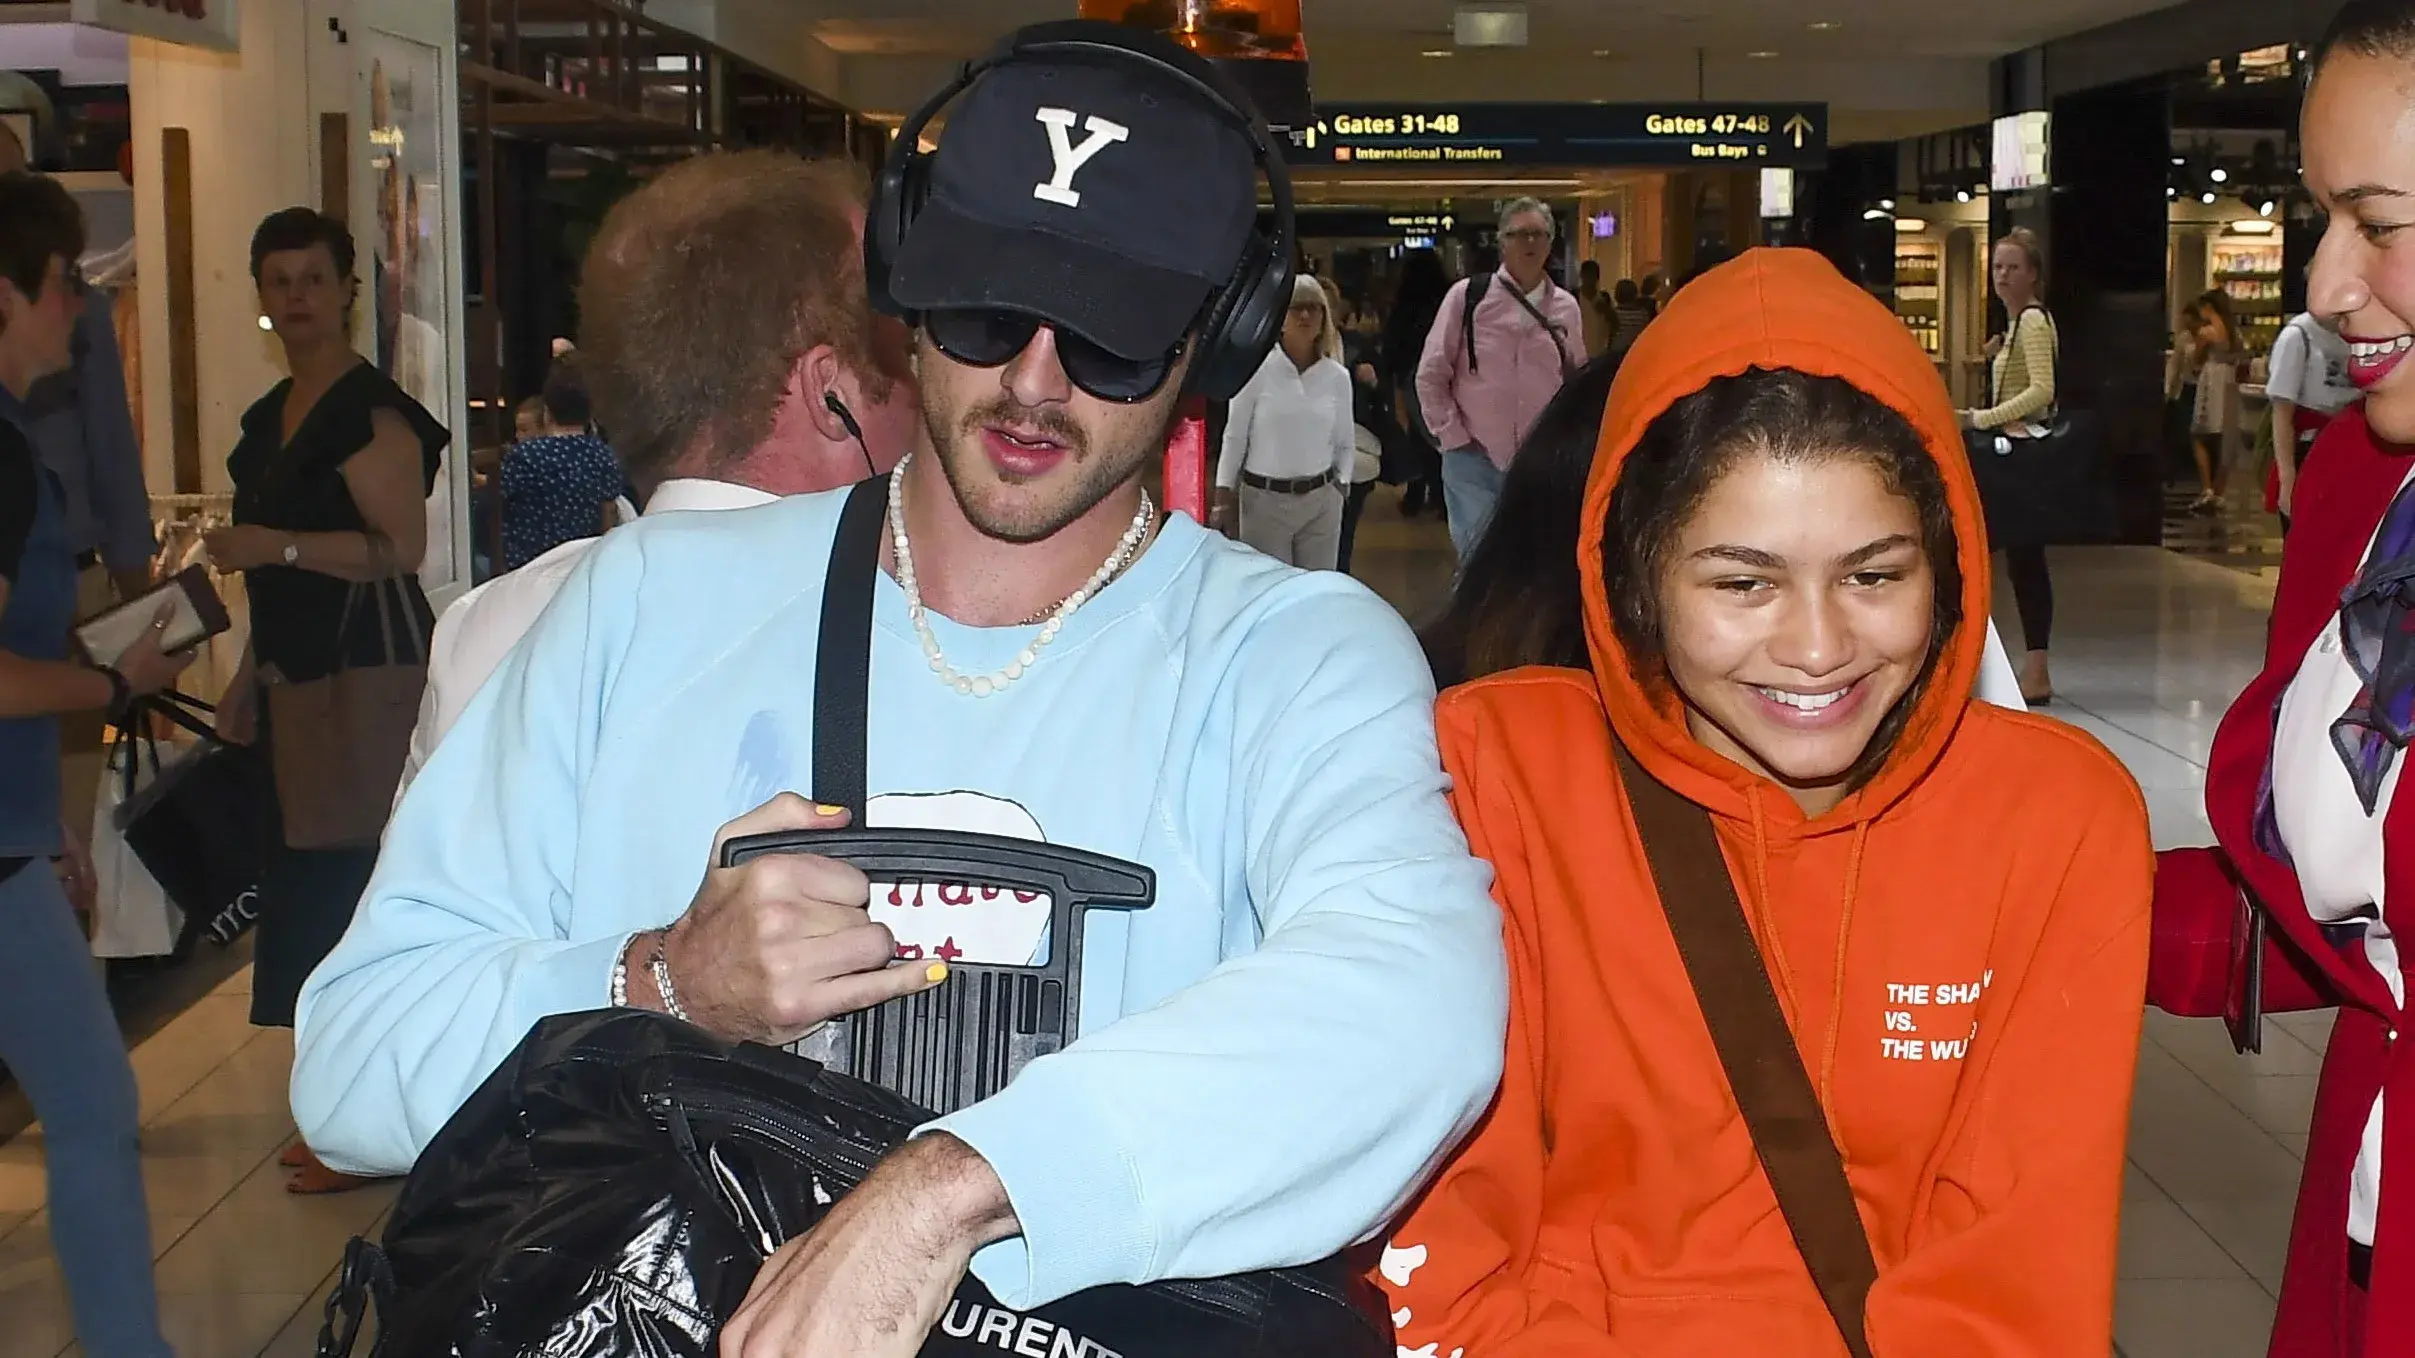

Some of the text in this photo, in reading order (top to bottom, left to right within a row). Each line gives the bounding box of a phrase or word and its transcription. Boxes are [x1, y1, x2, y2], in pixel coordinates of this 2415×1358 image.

[1334, 114, 1460, 134] Gates 31-48
[1646, 115, 1770, 133] Gates 47-48
[1033, 106, 1130, 208] Y
[1356, 147, 1502, 160] International Transfers
[1691, 144, 1748, 159] Bus Bays
[1886, 983, 1931, 1005] THE
[1884, 1010, 1918, 1032] VS.
[1880, 1038, 1925, 1061] THE
